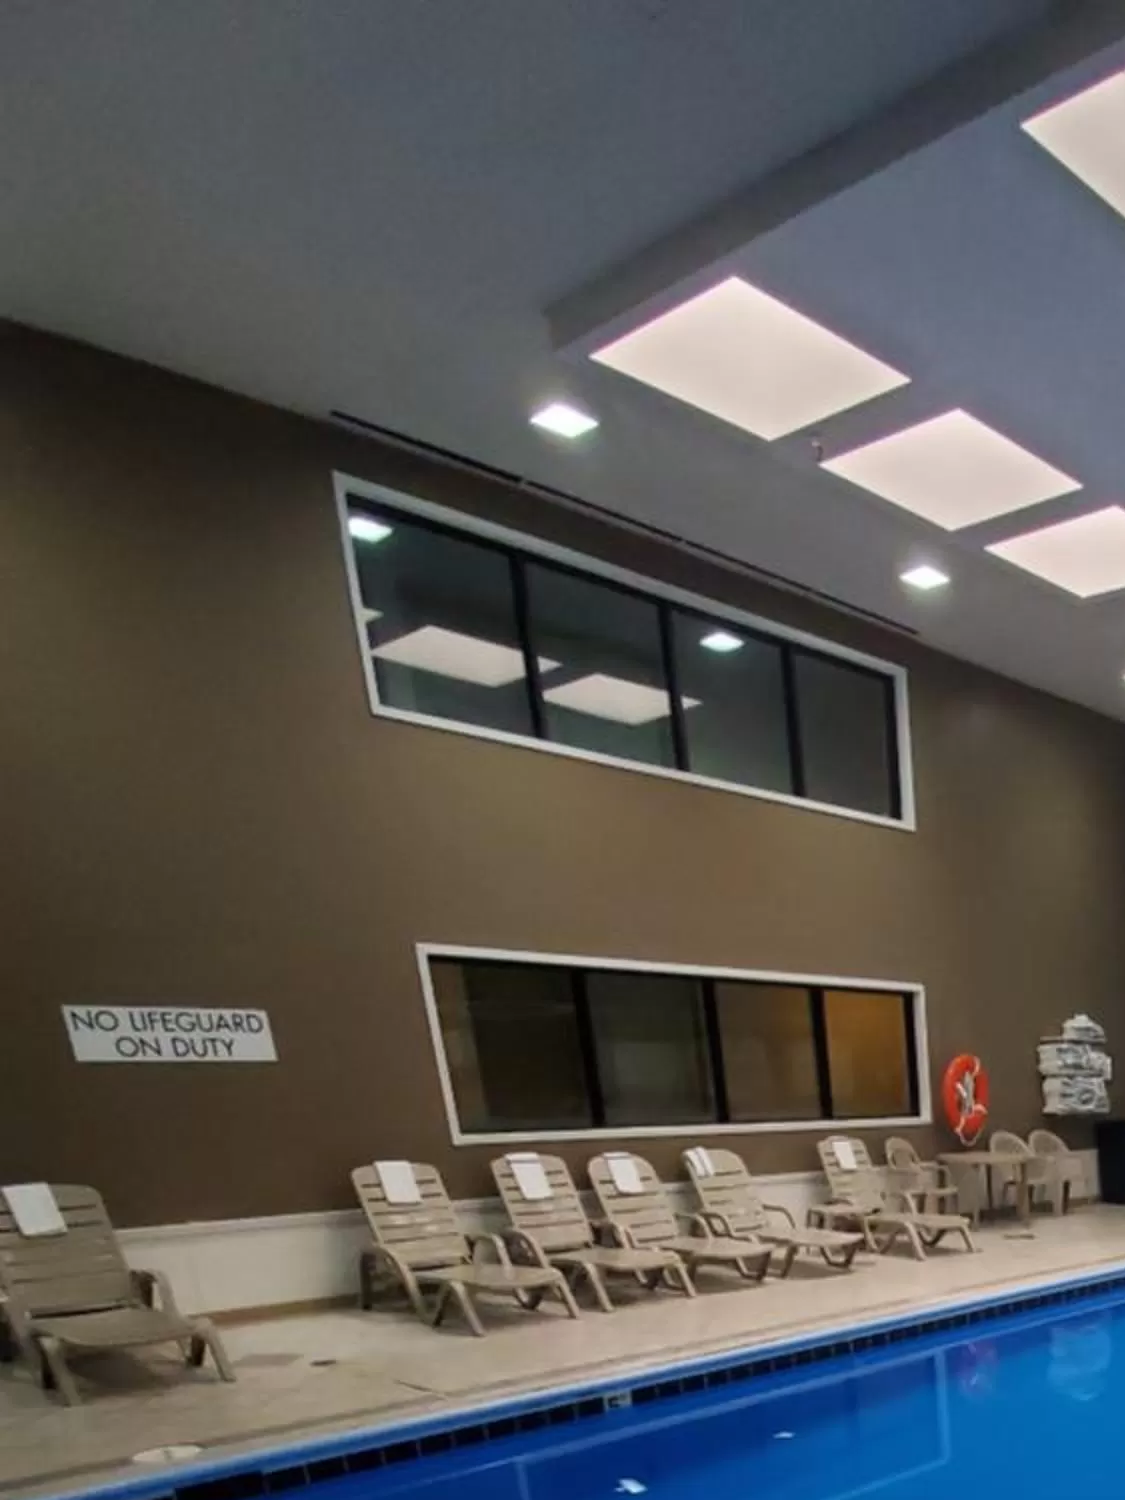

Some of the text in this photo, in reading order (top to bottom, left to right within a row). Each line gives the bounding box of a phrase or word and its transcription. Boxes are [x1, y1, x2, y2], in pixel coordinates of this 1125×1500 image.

[70, 1010, 264, 1034] NO LIFEGUARD
[115, 1036, 235, 1058] ON DUTY
